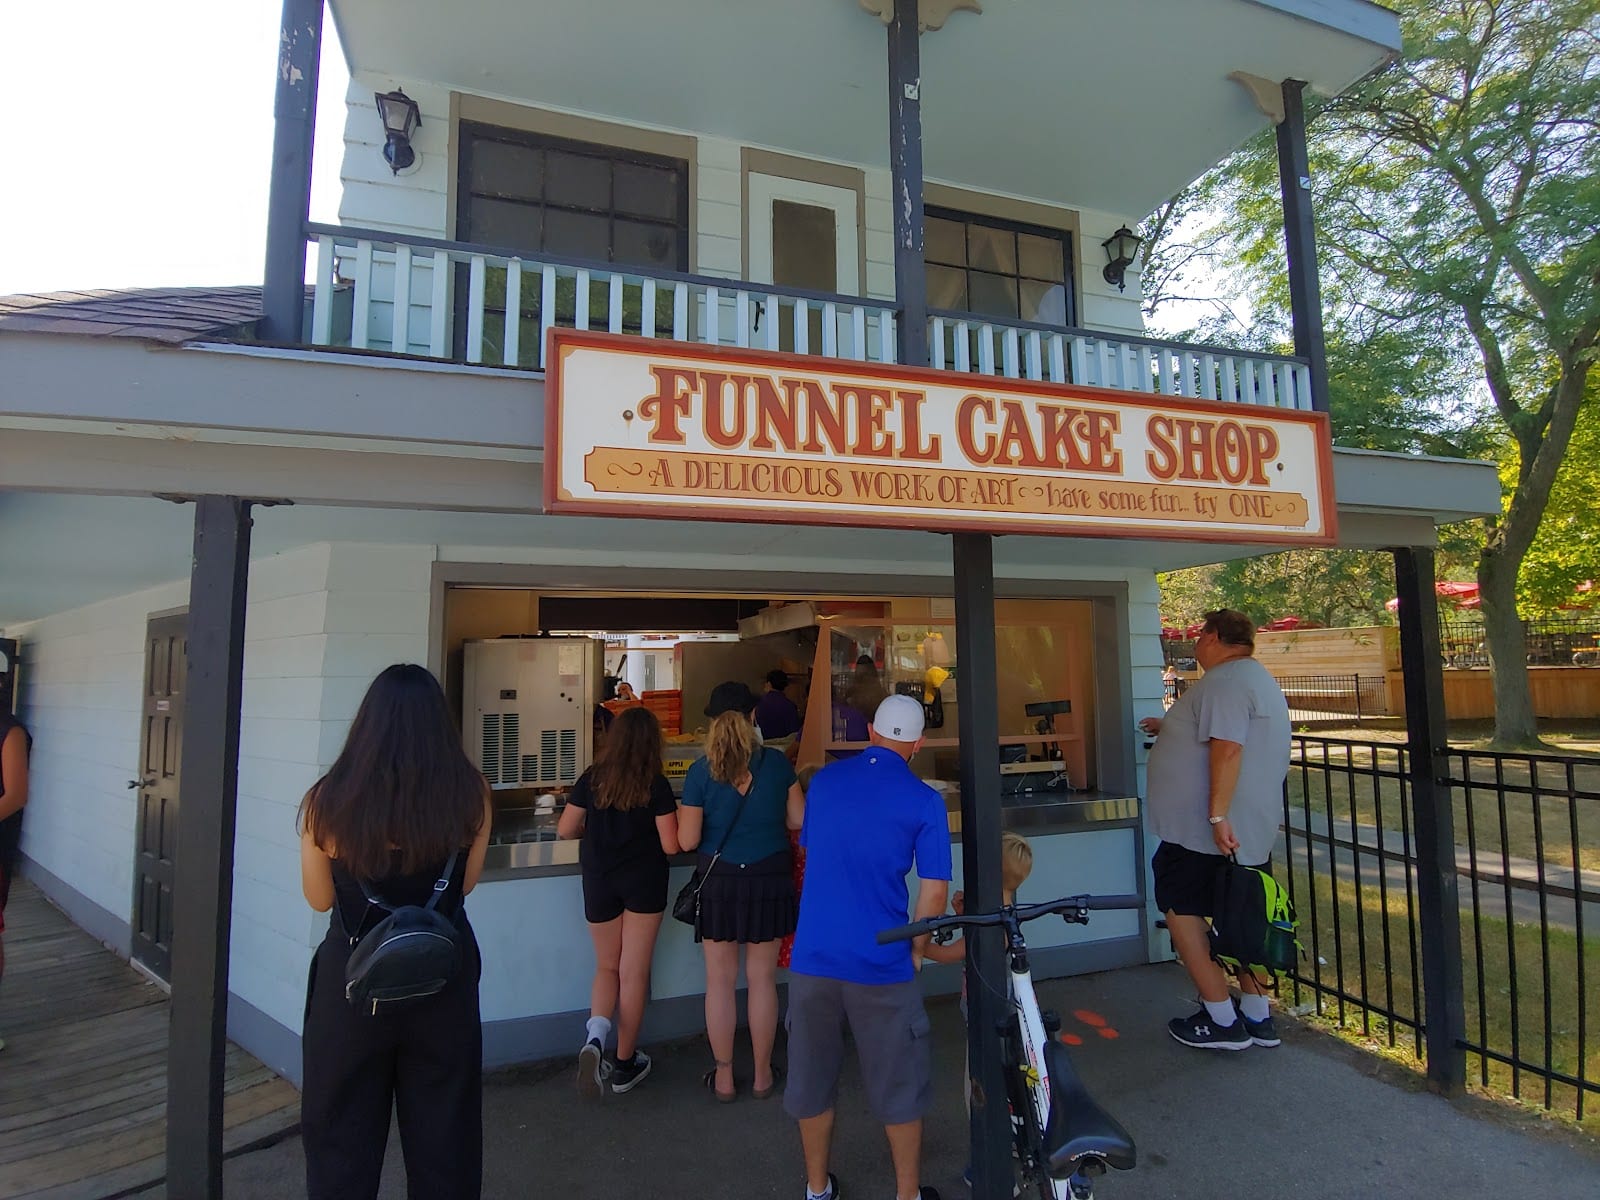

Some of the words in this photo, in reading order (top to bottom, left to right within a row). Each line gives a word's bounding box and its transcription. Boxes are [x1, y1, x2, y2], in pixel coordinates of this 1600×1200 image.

[638, 364, 943, 463] FUNNEL
[956, 394, 1124, 476] CAKE
[1145, 413, 1280, 487] SHOP
[648, 458, 674, 488] A
[683, 459, 843, 498] DELICIOUS
[850, 470, 934, 502] WORK
[938, 476, 967, 503] OF
[971, 476, 1019, 507] ART
[1045, 481, 1092, 511] have
[1098, 490, 1148, 512] some
[1192, 491, 1218, 520] try
[1229, 494, 1275, 519] ONE
